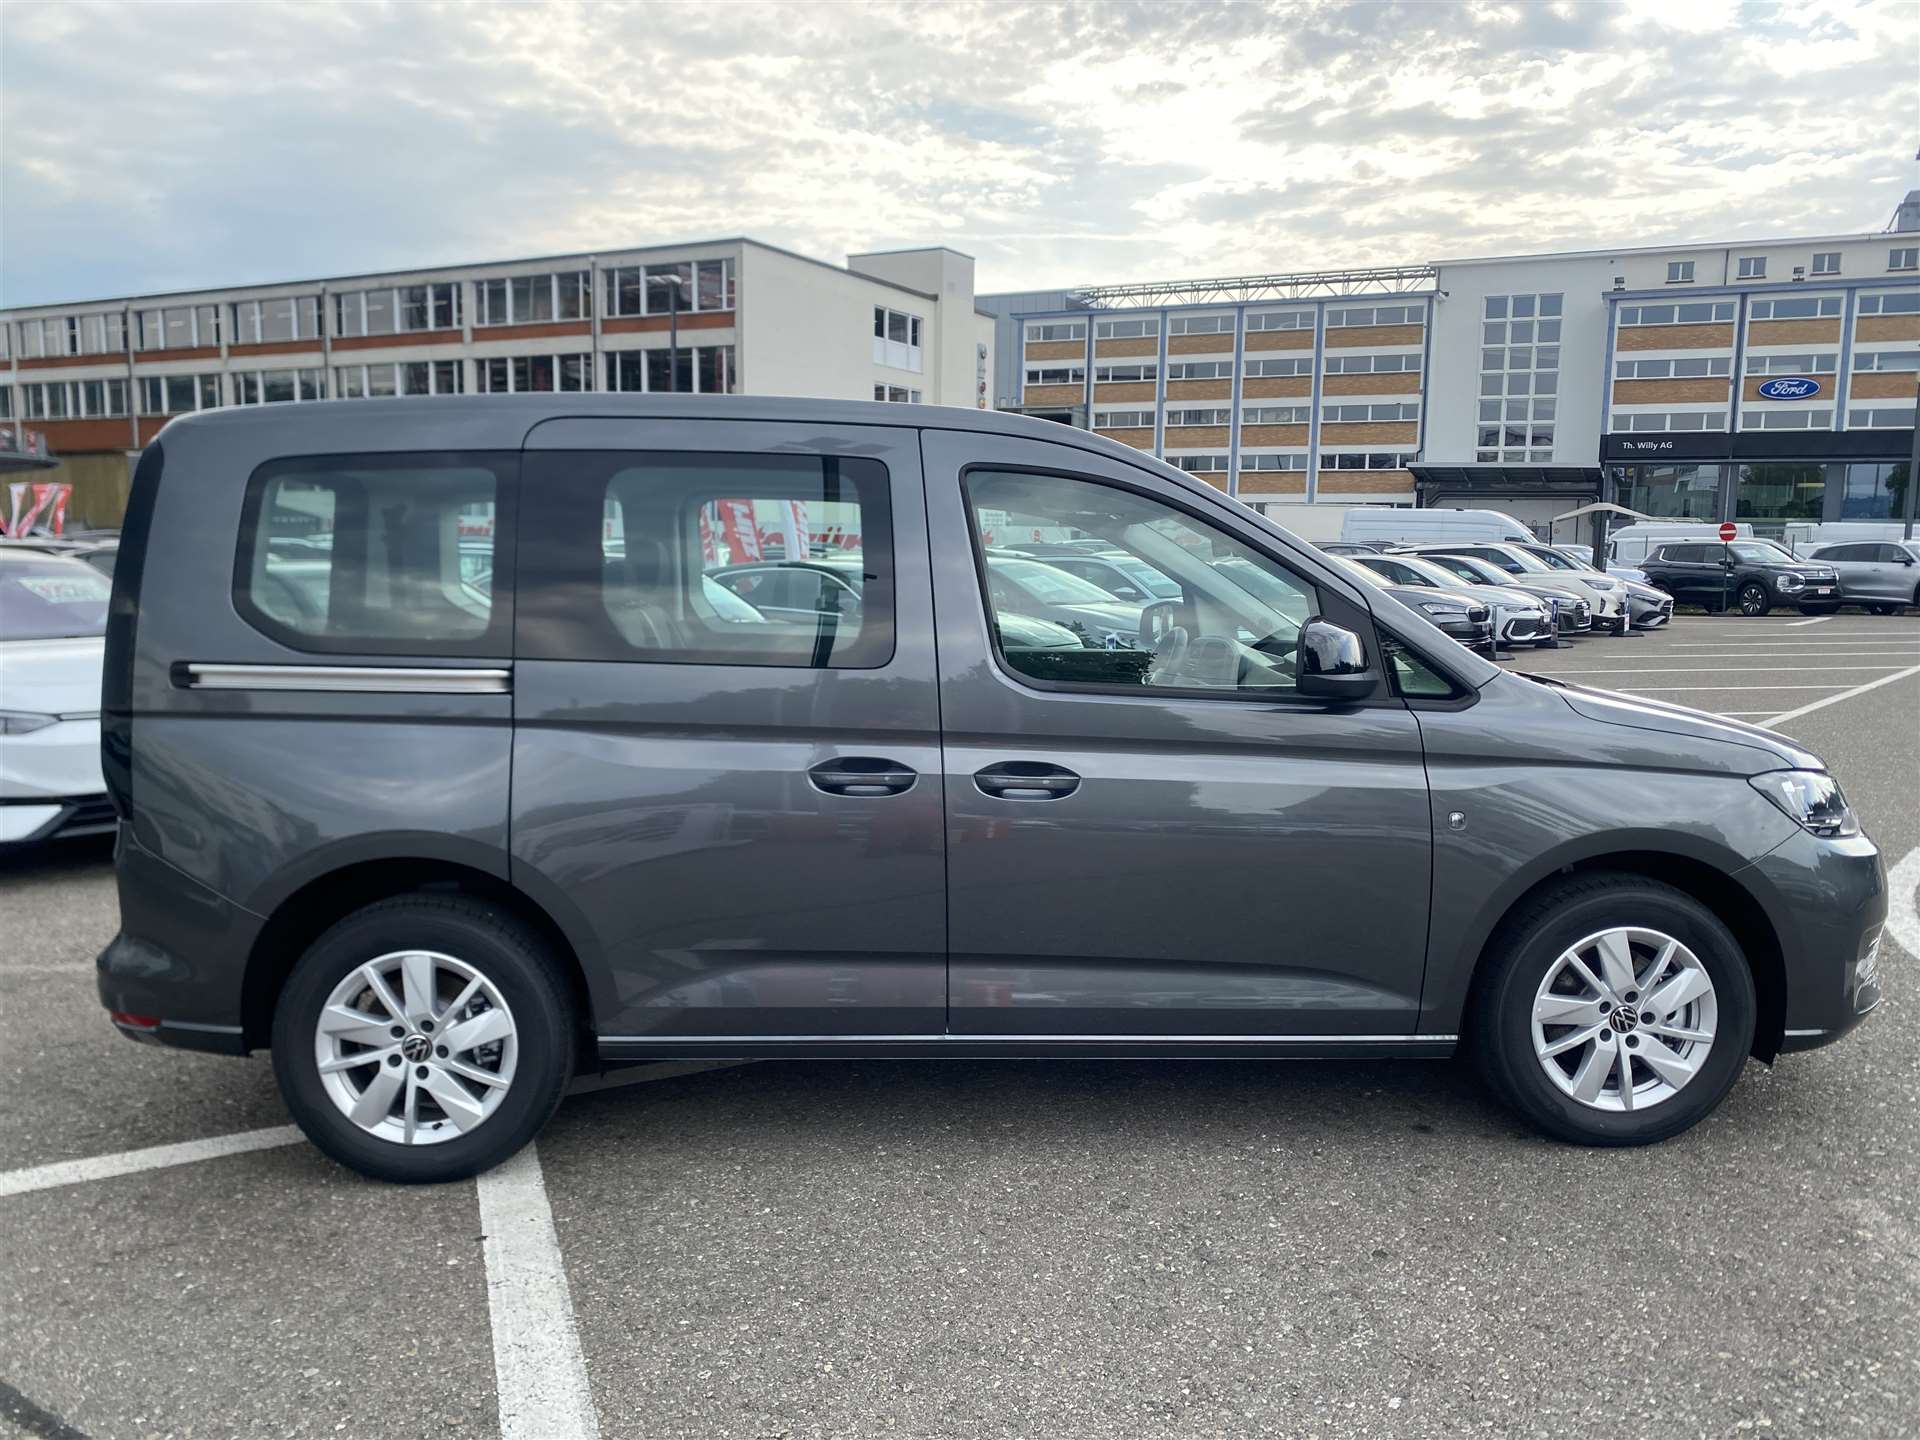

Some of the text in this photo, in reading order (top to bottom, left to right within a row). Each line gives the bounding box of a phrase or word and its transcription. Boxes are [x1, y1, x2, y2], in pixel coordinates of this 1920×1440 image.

[1770, 381, 1809, 394] Ford
[1623, 441, 1673, 451] Th. Willy AG
